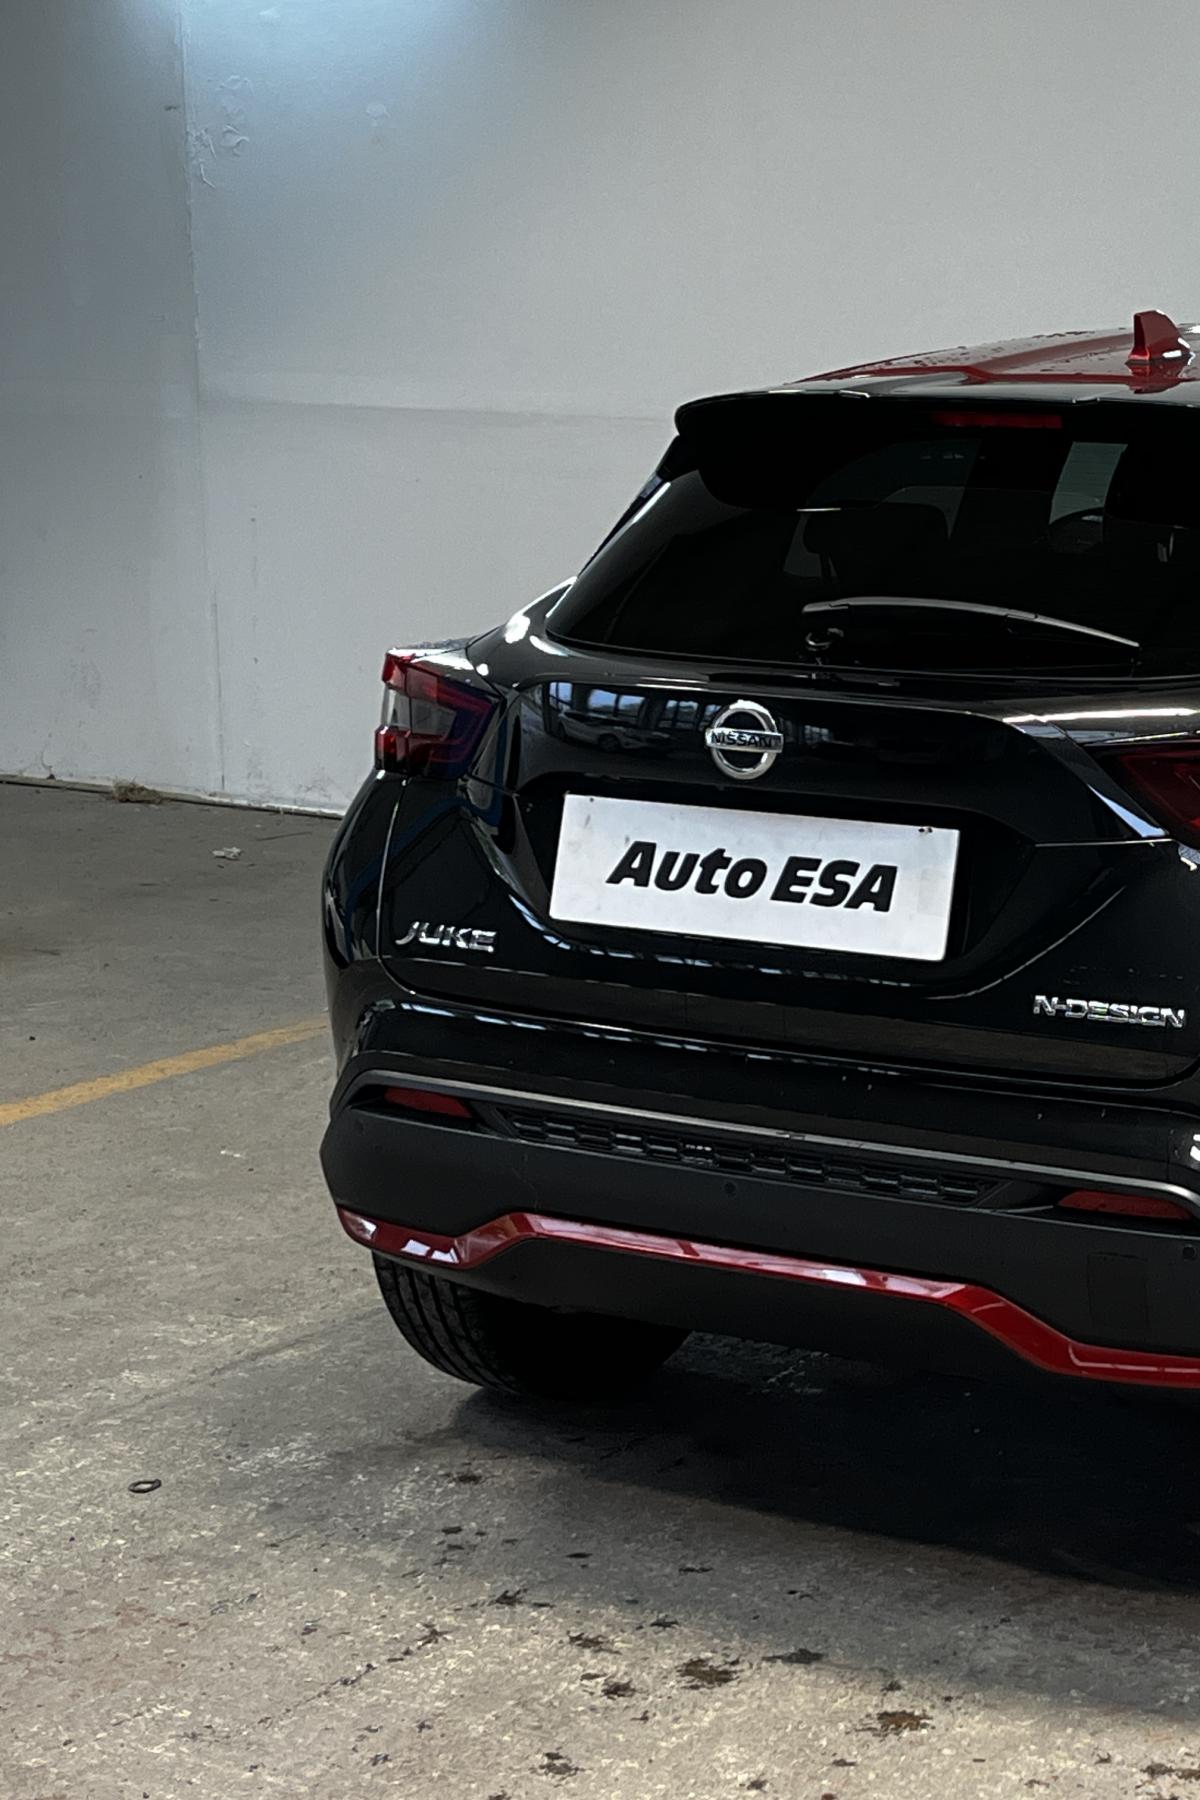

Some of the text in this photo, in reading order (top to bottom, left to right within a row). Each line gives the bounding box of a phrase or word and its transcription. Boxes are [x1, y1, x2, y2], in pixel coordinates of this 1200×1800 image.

[711, 731, 774, 748] NISSAN
[606, 840, 899, 913] Auto ESA
[395, 921, 497, 953] JUKE
[1032, 994, 1186, 1029] N-DESIGN
